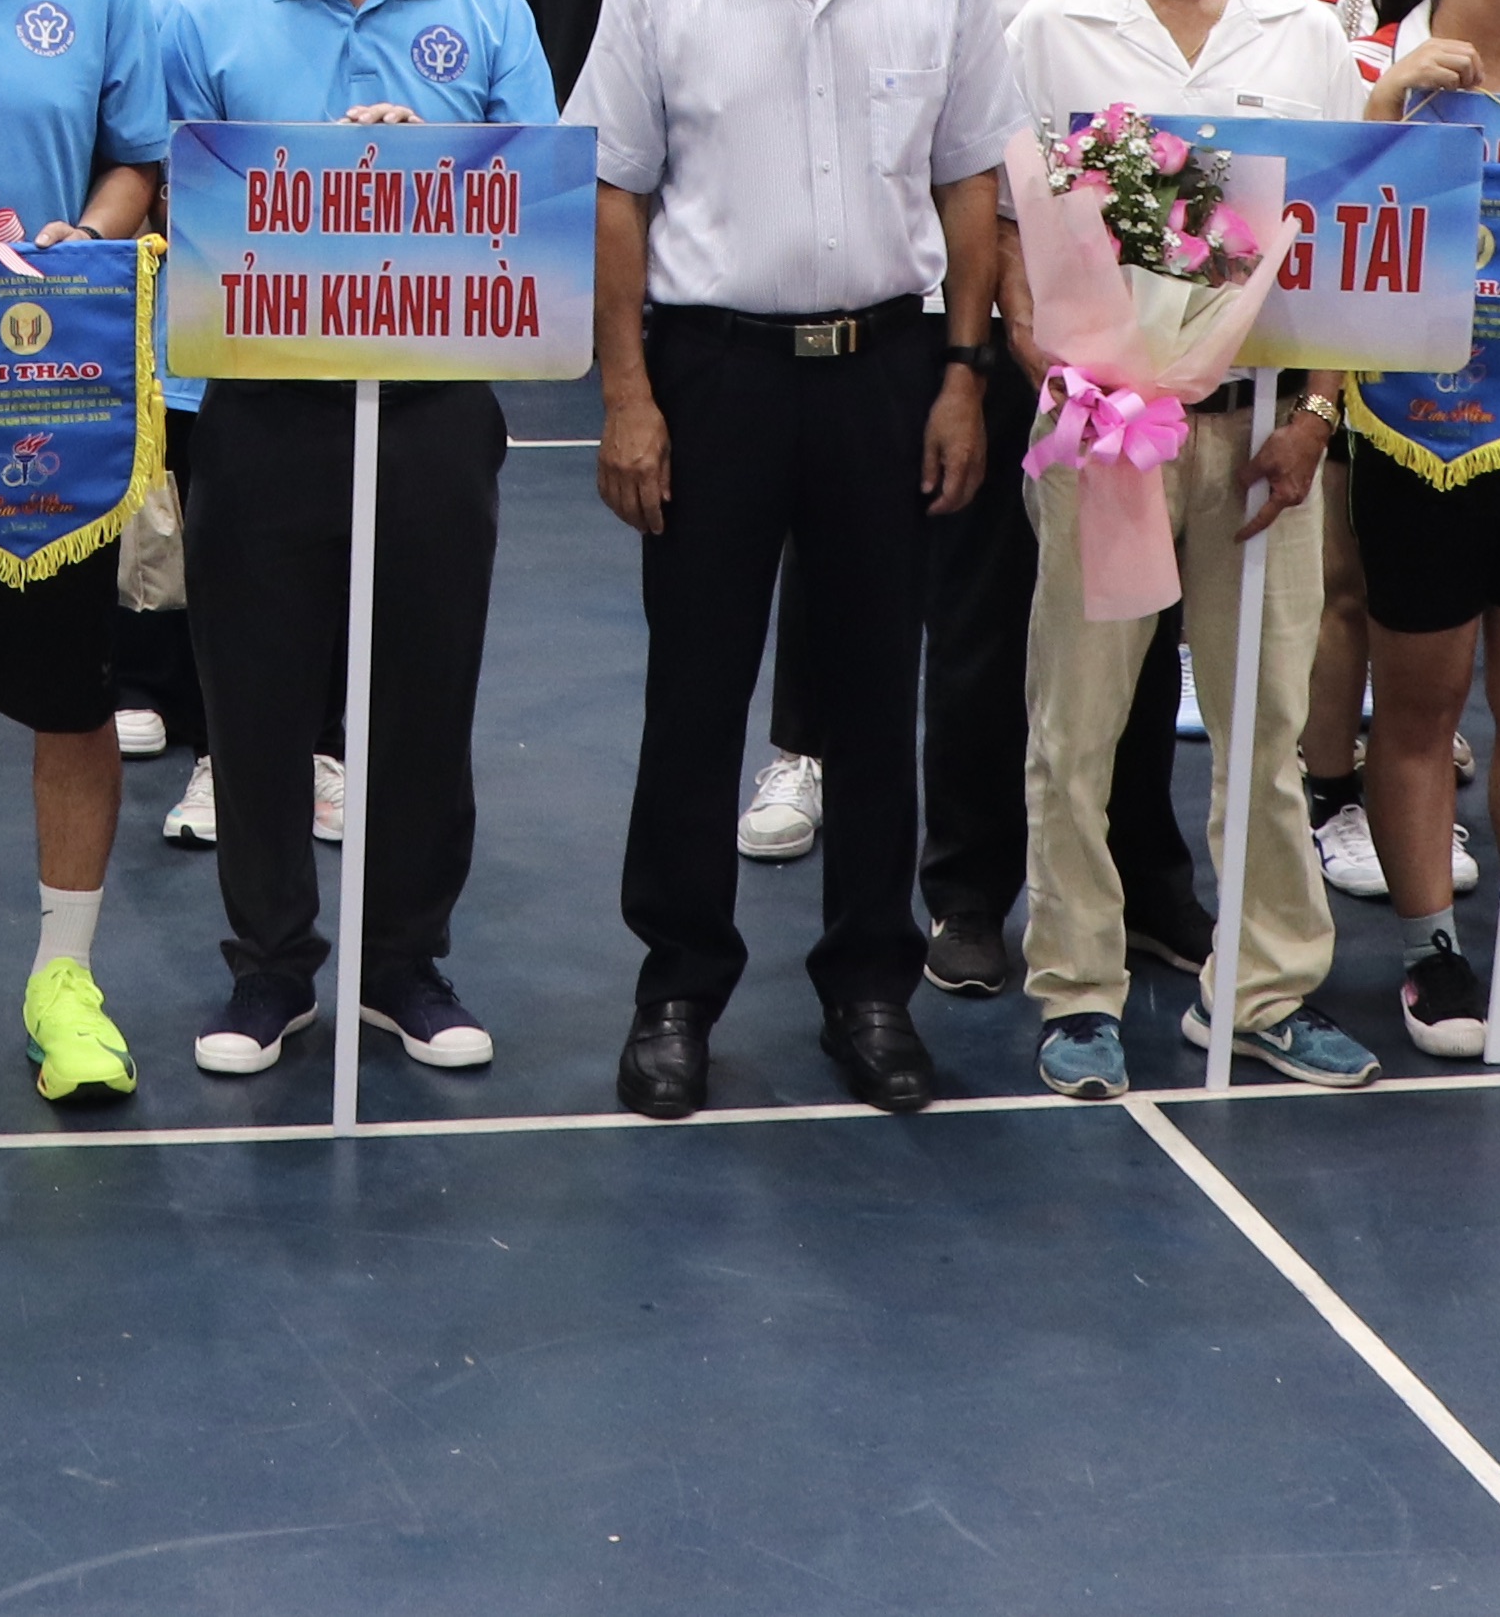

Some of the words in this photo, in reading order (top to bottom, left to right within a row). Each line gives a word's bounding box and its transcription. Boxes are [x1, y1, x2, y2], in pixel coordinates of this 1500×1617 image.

[247, 146, 312, 234] BẢO
[321, 144, 403, 234] HIỂM
[412, 156, 455, 235] XÃ
[463, 156, 519, 249] HỘI
[1336, 185, 1426, 294] TÀI
[221, 251, 308, 336] TỈNH
[321, 260, 451, 337] KHÁNH
[464, 259, 540, 338] HÒA
[14, 362, 102, 381] THAO
